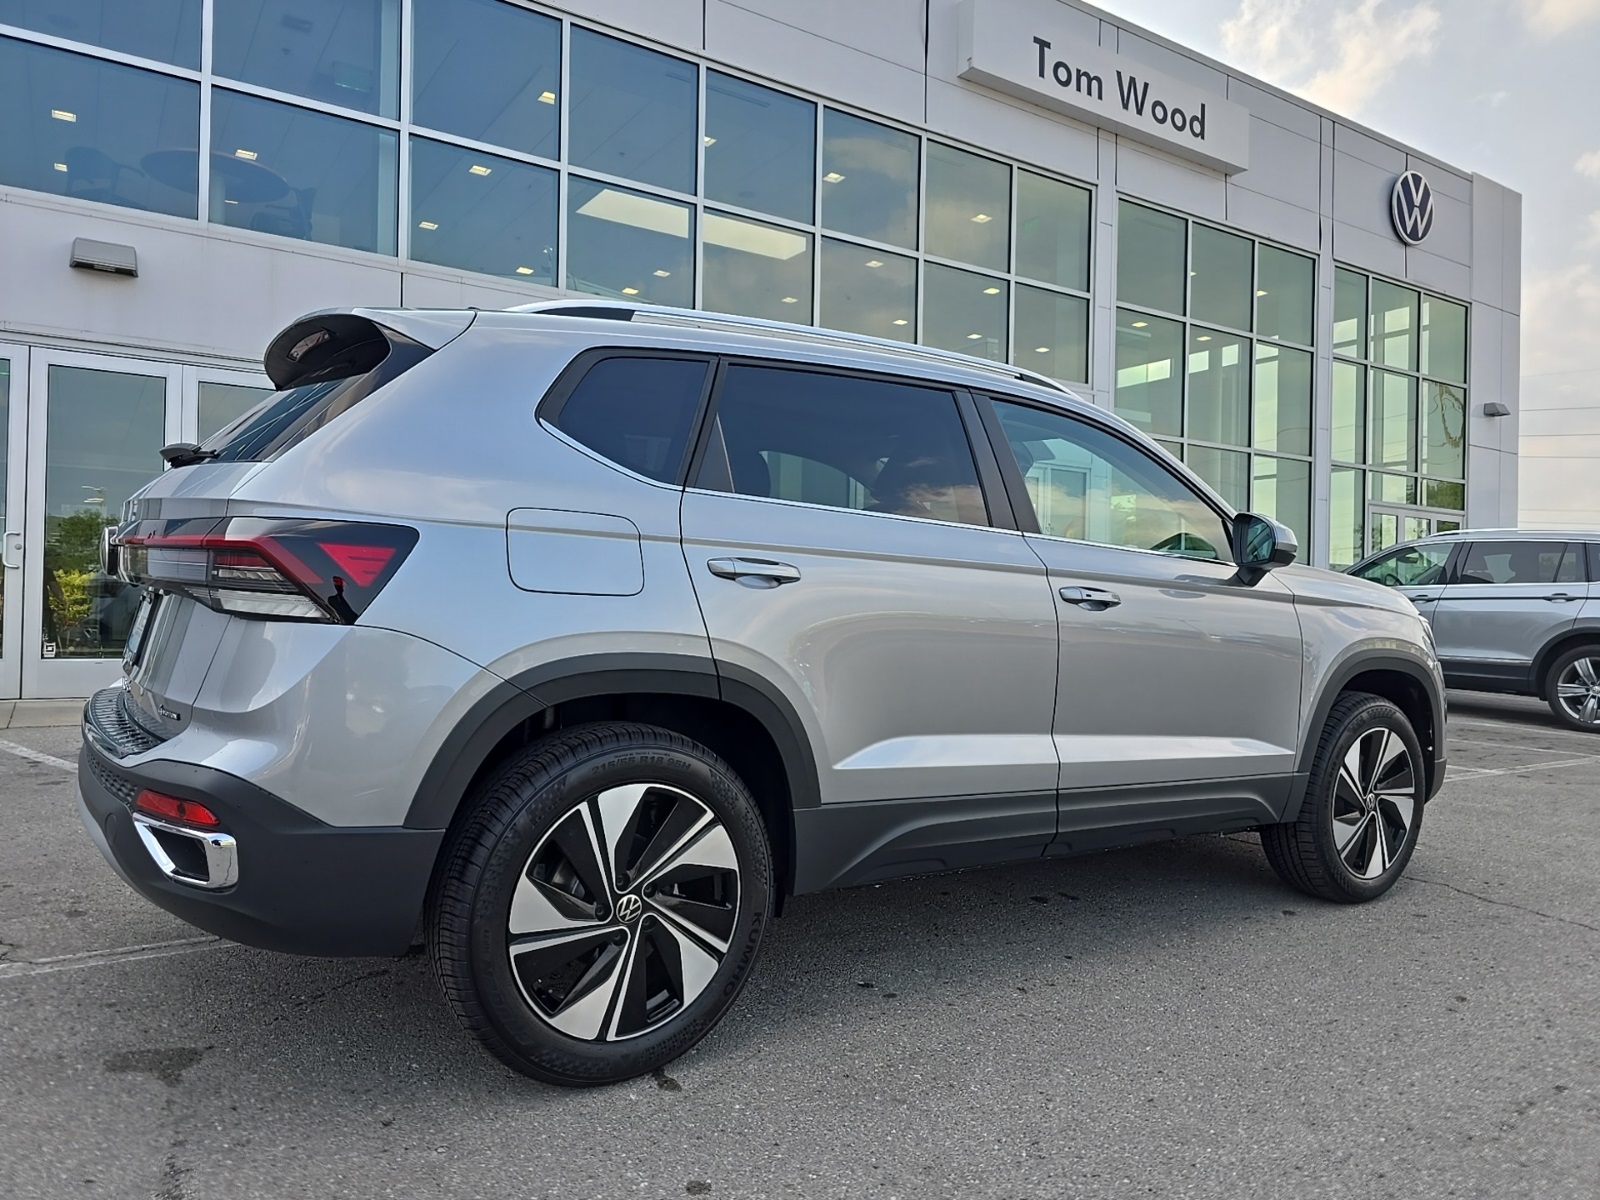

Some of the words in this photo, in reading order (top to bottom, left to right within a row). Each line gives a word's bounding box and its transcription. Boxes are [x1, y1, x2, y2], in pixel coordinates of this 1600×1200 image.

[1032, 36, 1103, 100] Tom
[1116, 70, 1206, 141] Wood
[1393, 170, 1434, 244] VW
[616, 894, 642, 924] VW
[723, 912, 762, 997] KUMHO
